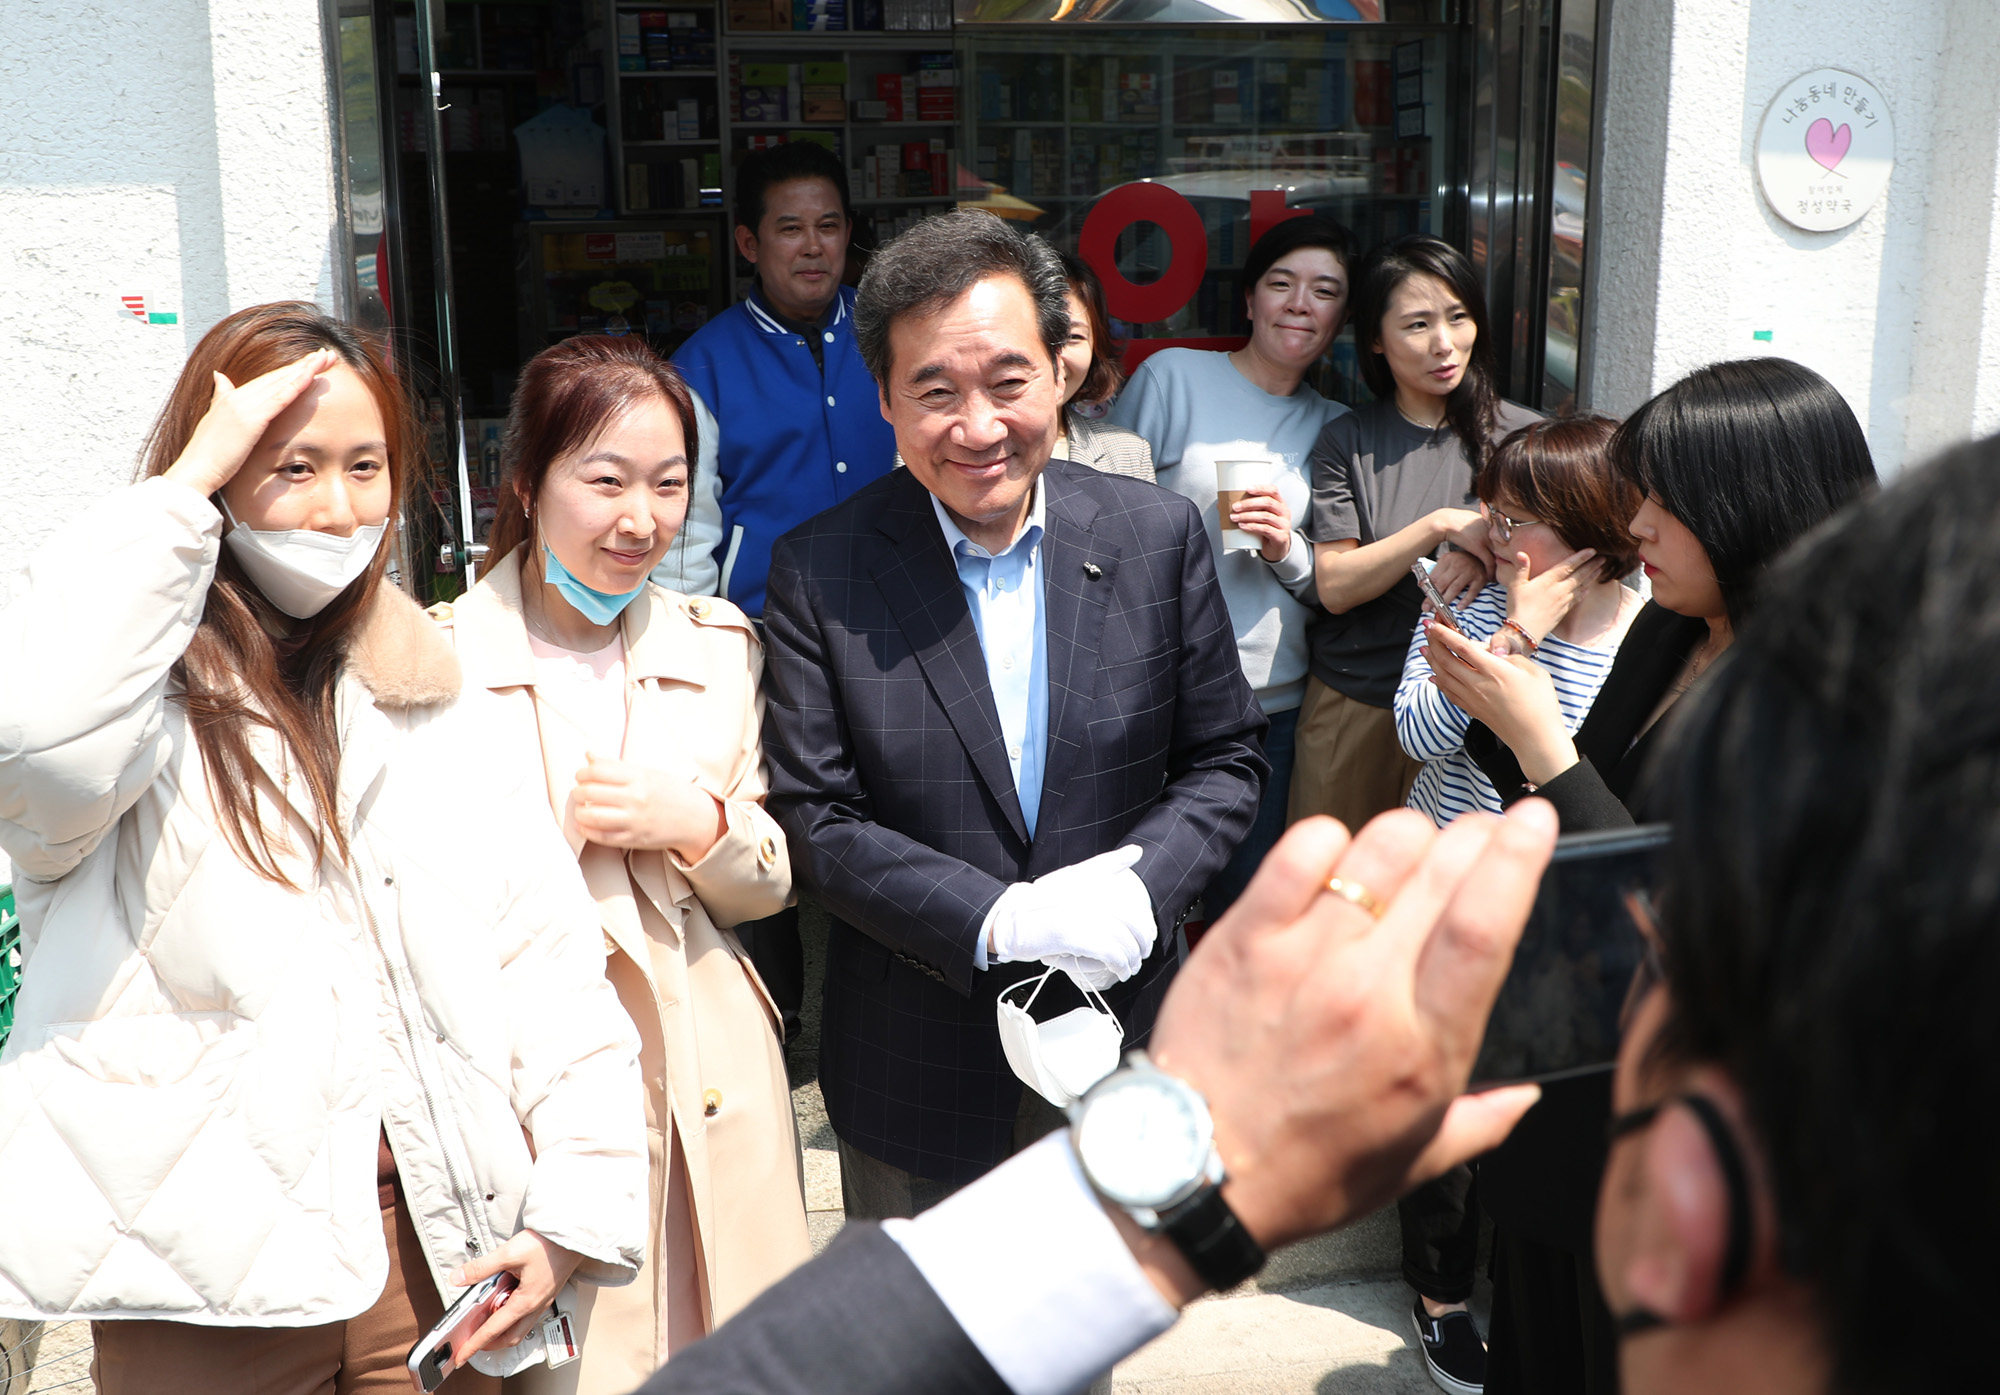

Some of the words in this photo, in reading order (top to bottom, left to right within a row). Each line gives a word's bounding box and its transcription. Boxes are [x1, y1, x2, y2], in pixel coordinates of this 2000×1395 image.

[1782, 82, 1836, 124] 나눔동네
[1844, 86, 1879, 129] 만들기
[1797, 199, 1853, 214] 정성약국
